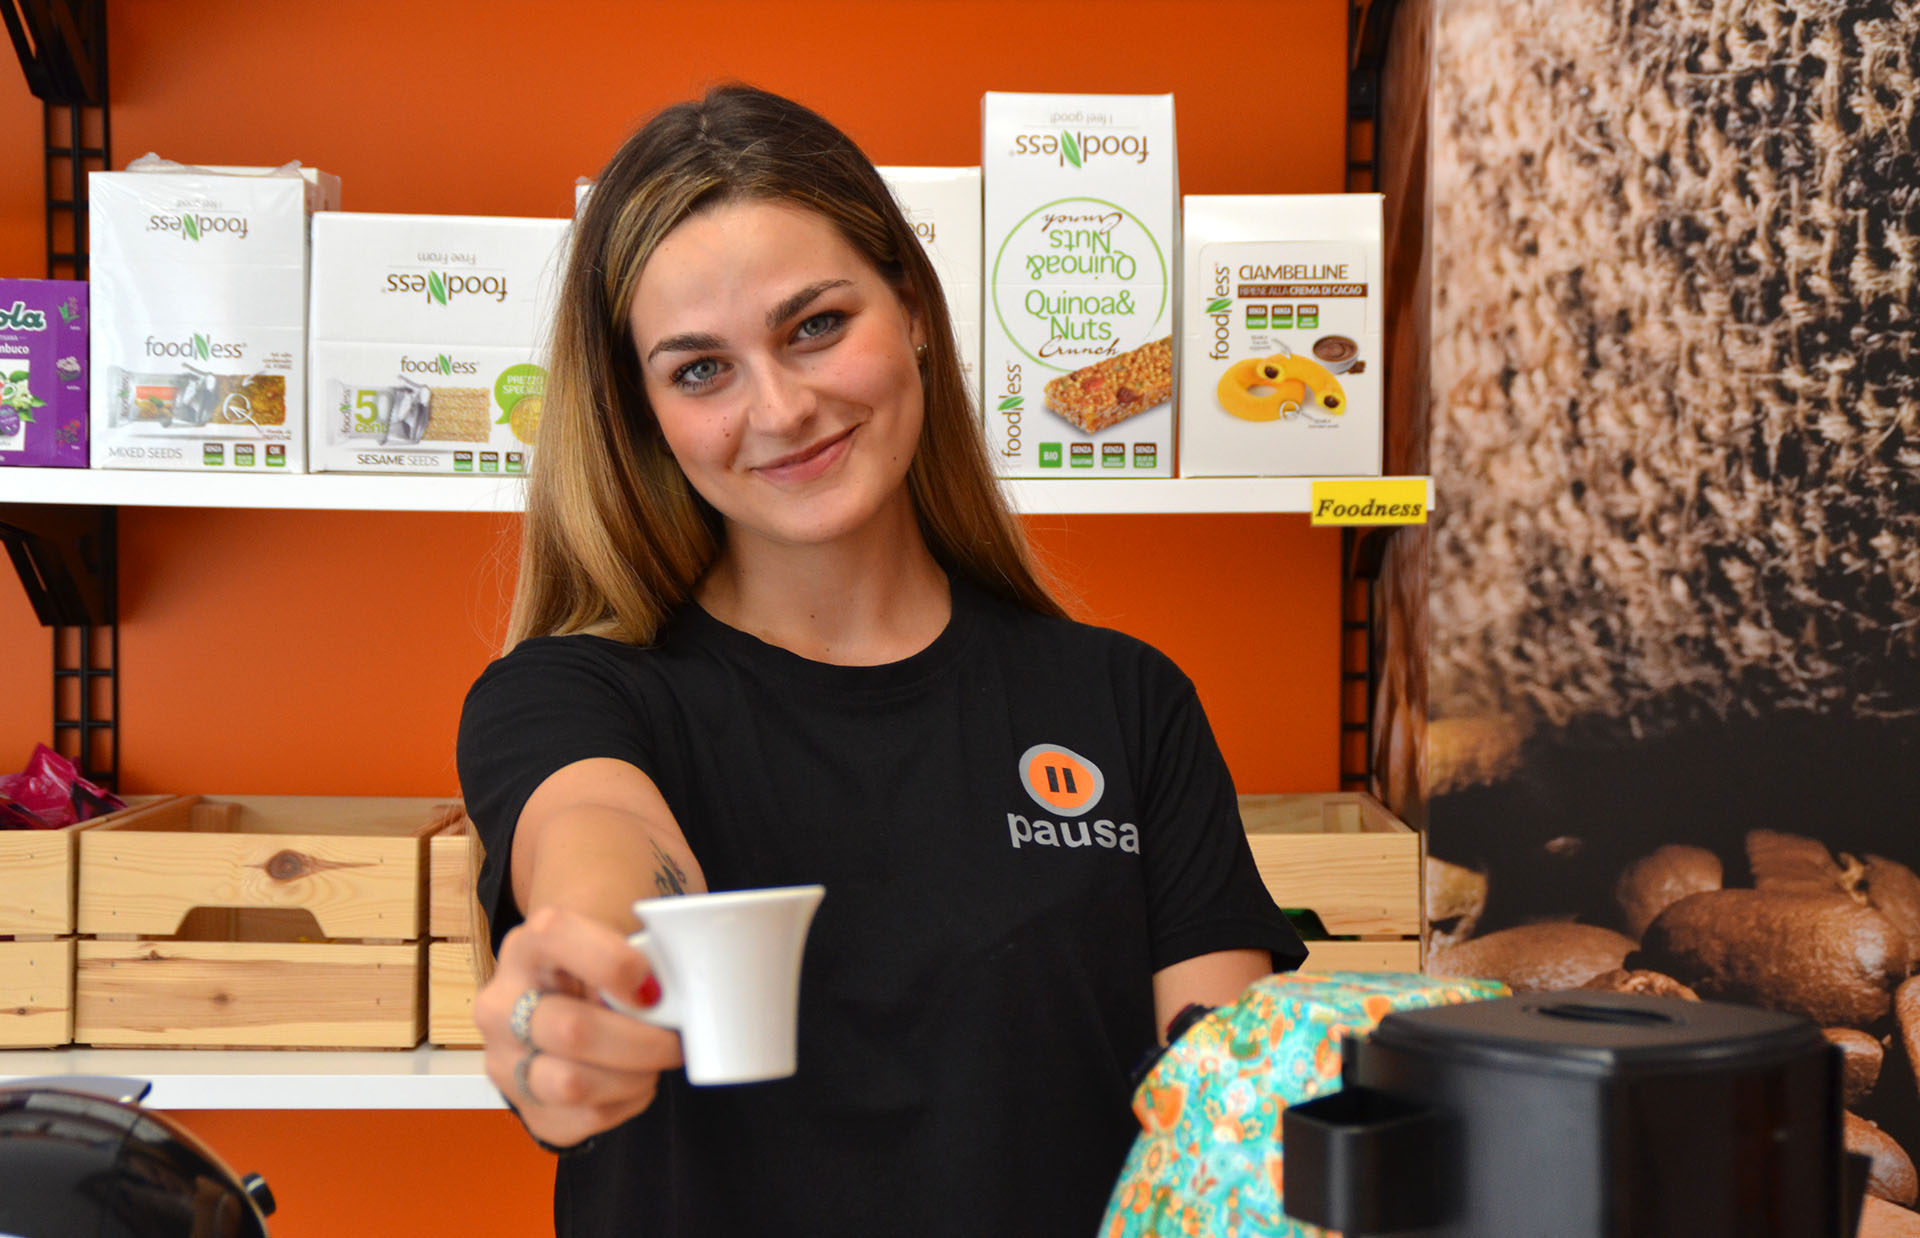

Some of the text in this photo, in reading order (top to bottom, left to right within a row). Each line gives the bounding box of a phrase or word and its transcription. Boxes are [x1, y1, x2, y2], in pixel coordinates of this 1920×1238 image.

[1087, 113, 1106, 124] feel
[1041, 212, 1123, 236] Crunch
[1049, 230, 1111, 255] Nuts
[417, 252, 477, 265] Free From
[1026, 250, 1137, 281] Quinoa&
[1239, 264, 1349, 280] CIAMBELLINE
[1269, 286, 1288, 296] ALLA
[1289, 285, 1320, 295] CREMA
[1321, 285, 1330, 295] DI
[1331, 285, 1362, 295] CACAO
[1025, 289, 1135, 320] Quinoa&
[1051, 316, 1111, 341] Nuts
[1039, 334, 1119, 359] Crunch
[354, 389, 378, 424] 5
[109, 446, 183, 459] MIXED SEEDS
[1043, 451, 1058, 461] BIO
[1071, 445, 1092, 454] SENZA
[1103, 445, 1124, 454] SENZA
[1135, 445, 1155, 454] SENZA
[357, 454, 440, 466] SESAME SEEDS
[1316, 499, 1421, 517] Foodness
[1007, 813, 1140, 855] pausa
